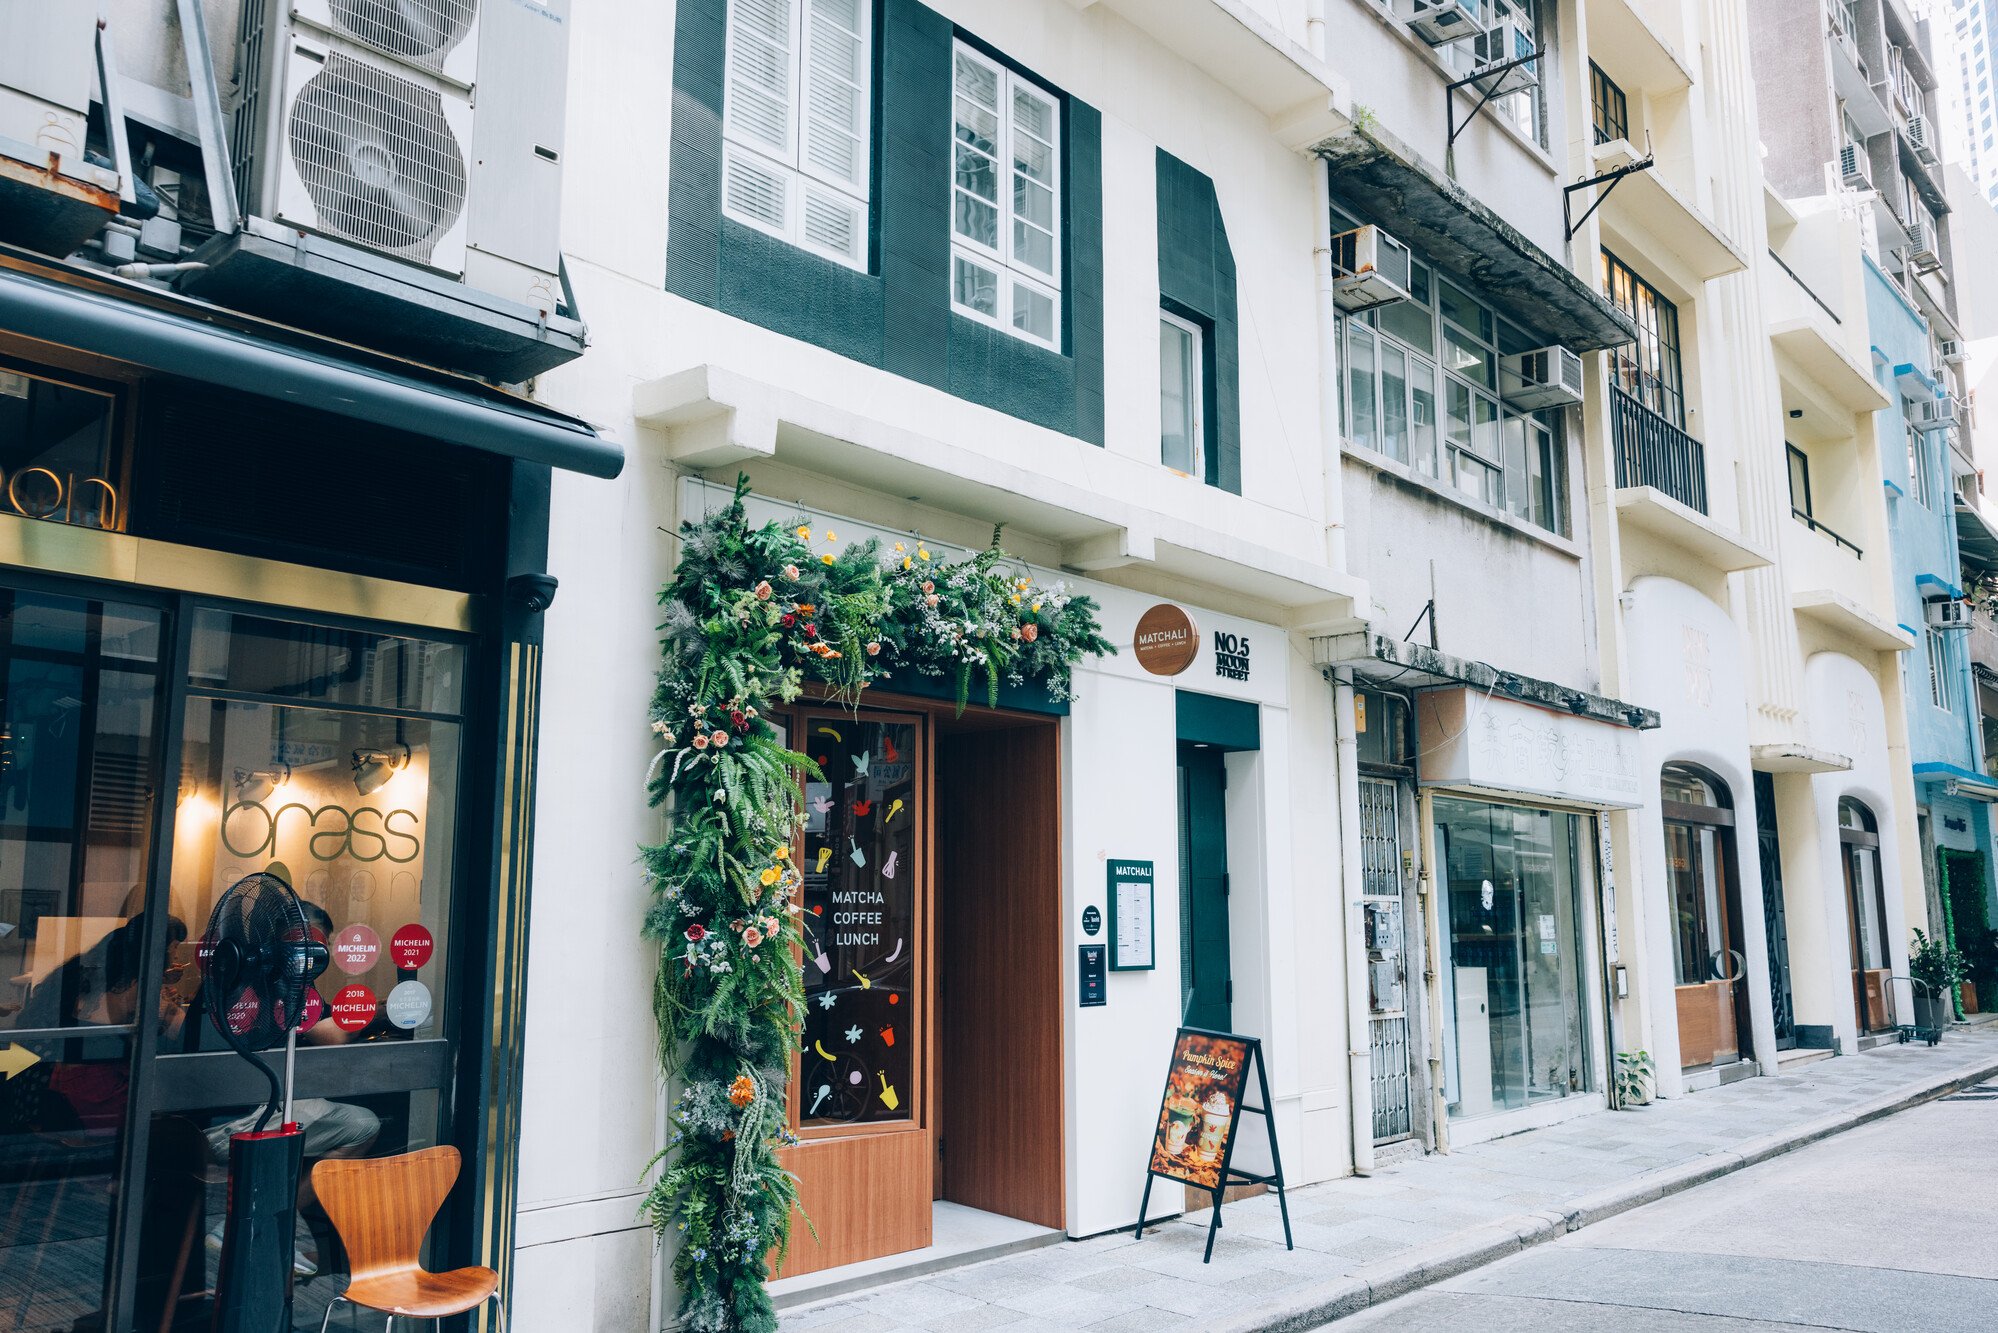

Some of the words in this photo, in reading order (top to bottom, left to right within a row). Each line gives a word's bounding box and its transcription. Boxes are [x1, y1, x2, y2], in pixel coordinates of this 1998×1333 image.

[0, 465, 117, 530] on
[1139, 628, 1187, 645] MATCHALI
[1214, 631, 1250, 657] NO.5
[1215, 652, 1250, 671] MOON
[1215, 666, 1250, 681] STREET
[221, 779, 420, 864] brass
[1115, 866, 1152, 877] MATCHALI
[832, 891, 884, 904] MATCHA
[833, 912, 882, 925] COFFEE
[394, 939, 430, 947] MICHELIN
[836, 933, 879, 946] LUNCH
[337, 945, 376, 953] MICHELIN
[346, 954, 367, 963] 2022
[345, 990, 365, 998] 2018
[332, 1003, 376, 1012] MICHELIN
[389, 1001, 428, 1010] MICHELIN
[1182, 1050, 1215, 1066] Pumpkin
[1215, 1055, 1236, 1070] Spice
